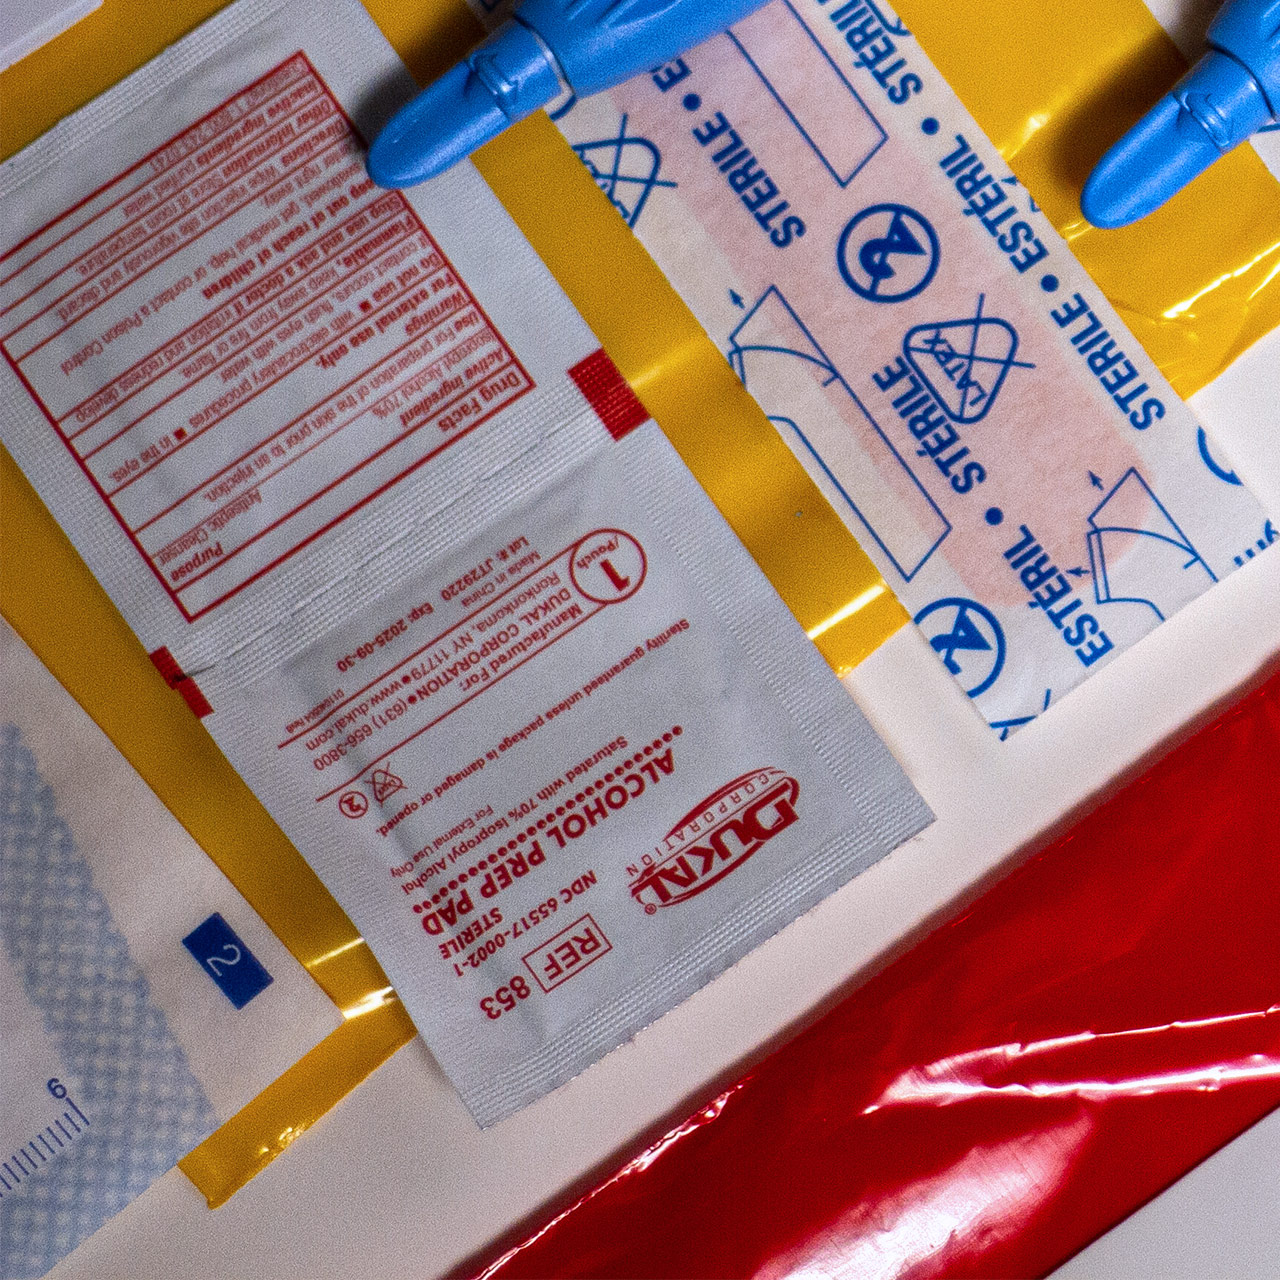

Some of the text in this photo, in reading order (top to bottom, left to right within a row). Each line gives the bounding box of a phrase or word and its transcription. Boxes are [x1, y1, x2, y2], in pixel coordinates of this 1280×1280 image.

[692, 113, 807, 249] STERILE
[403, 285, 466, 336] Warnings
[938, 135, 1048, 275] ESTÉRIL
[1051, 293, 1165, 431] STERILE
[397, 344, 506, 428] Active ingredient
[436, 370, 521, 434] Drug Facts
[873, 356, 1114, 667] STÉRILE ESTÉRIL
[169, 540, 224, 583] Purpose
[506, 535, 529, 554] Lot
[575, 531, 620, 570] /Pouch
[599, 556, 631, 592] 1
[405, 600, 434, 624] Exp:
[470, 570, 560, 634] Ronkonkoma,
[517, 586, 571, 627] DUKAL
[335, 618, 408, 673] 2025-09-30
[407, 648, 450, 681] 11779
[451, 631, 473, 653] NY
[458, 602, 583, 692] Manufactured For:
[304, 680, 403, 751] www.dukal.com
[311, 723, 373, 771] 656-3800
[374, 617, 690, 838] Sterility guaranteed unless package is damaged or opened.
[400, 734, 628, 896] Saturated with 70% Isopropyl Alcohol
[420, 747, 677, 937] ALCOHOL PREP PAD
[624, 771, 770, 878] CORPORATION
[622, 774, 808, 923] DUKAL
[437, 906, 503, 960] STERILE
[452, 869, 597, 977] NDC 65517-0002-1
[477, 926, 601, 1021] REF 853
